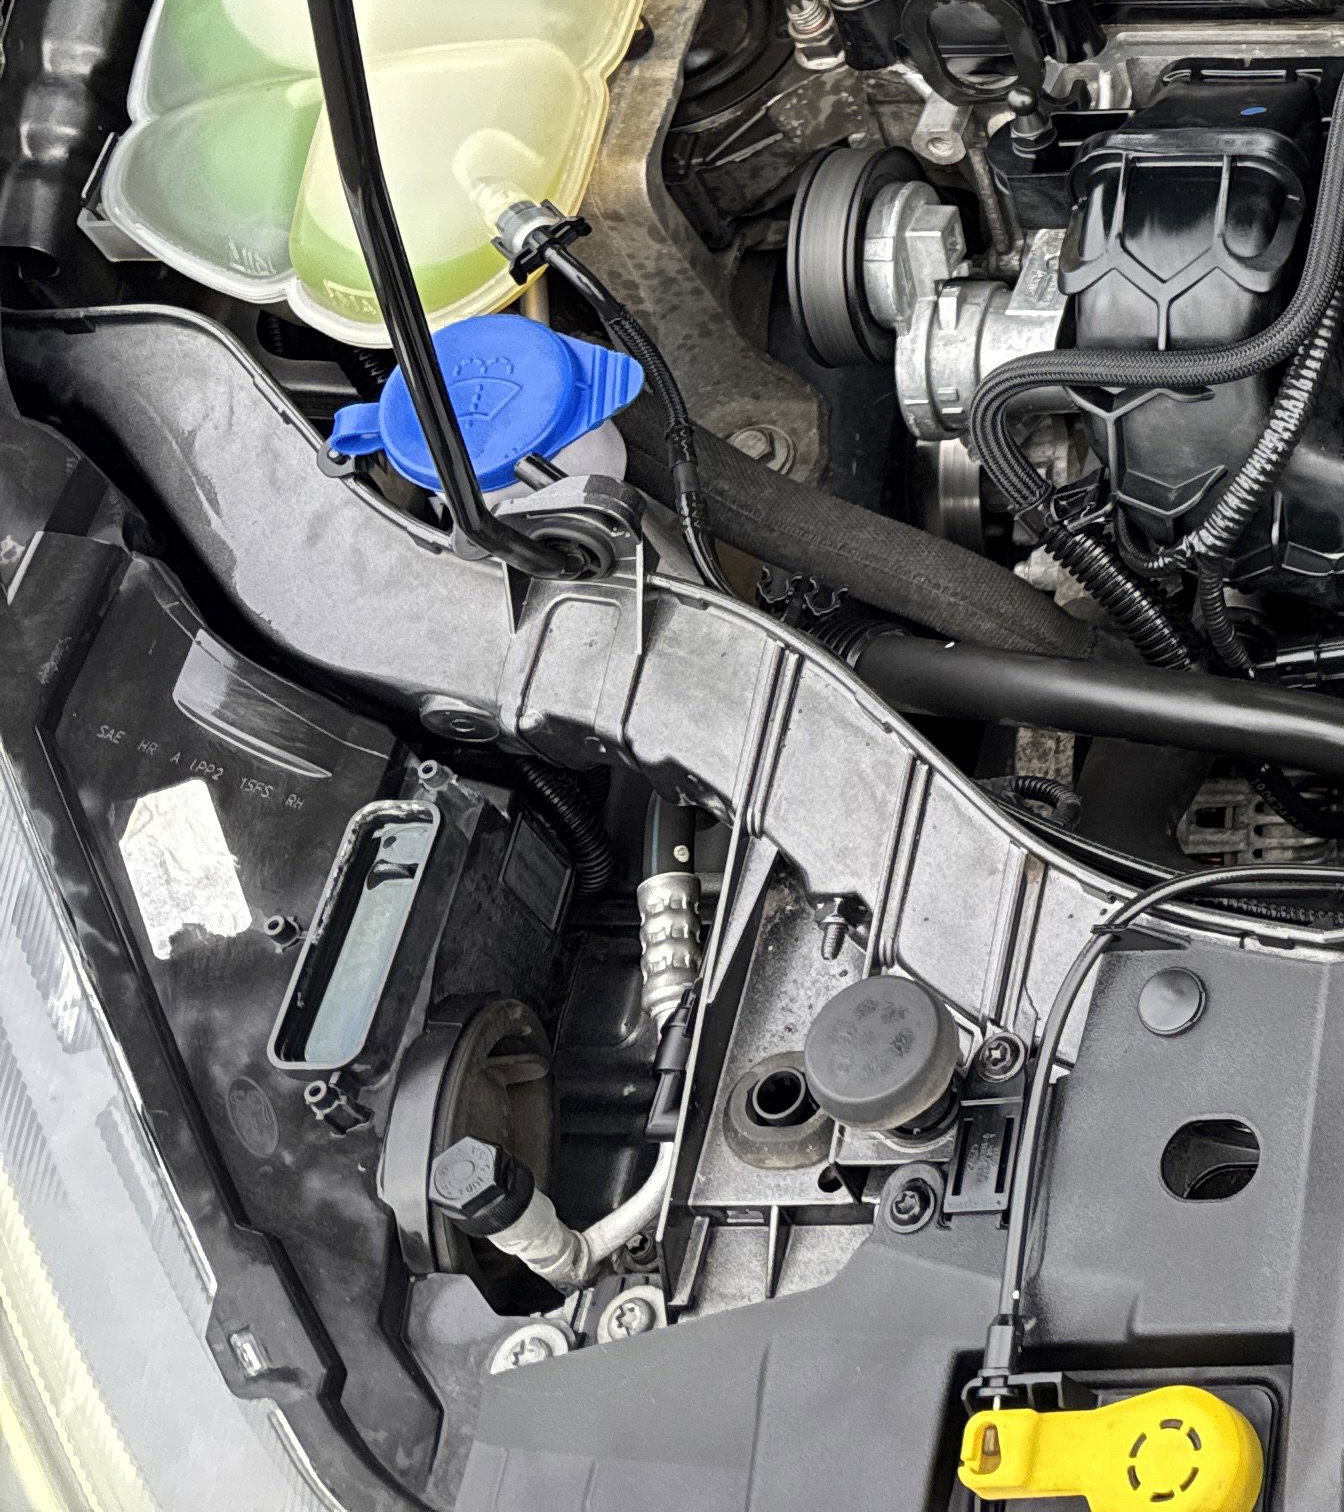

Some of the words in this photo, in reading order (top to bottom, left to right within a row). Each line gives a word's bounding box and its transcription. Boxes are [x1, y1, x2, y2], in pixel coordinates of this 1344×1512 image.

[97, 724, 126, 745] SAE
[137, 740, 158, 756] HR
[170, 752, 181, 764] A
[285, 794, 304, 809] RH
